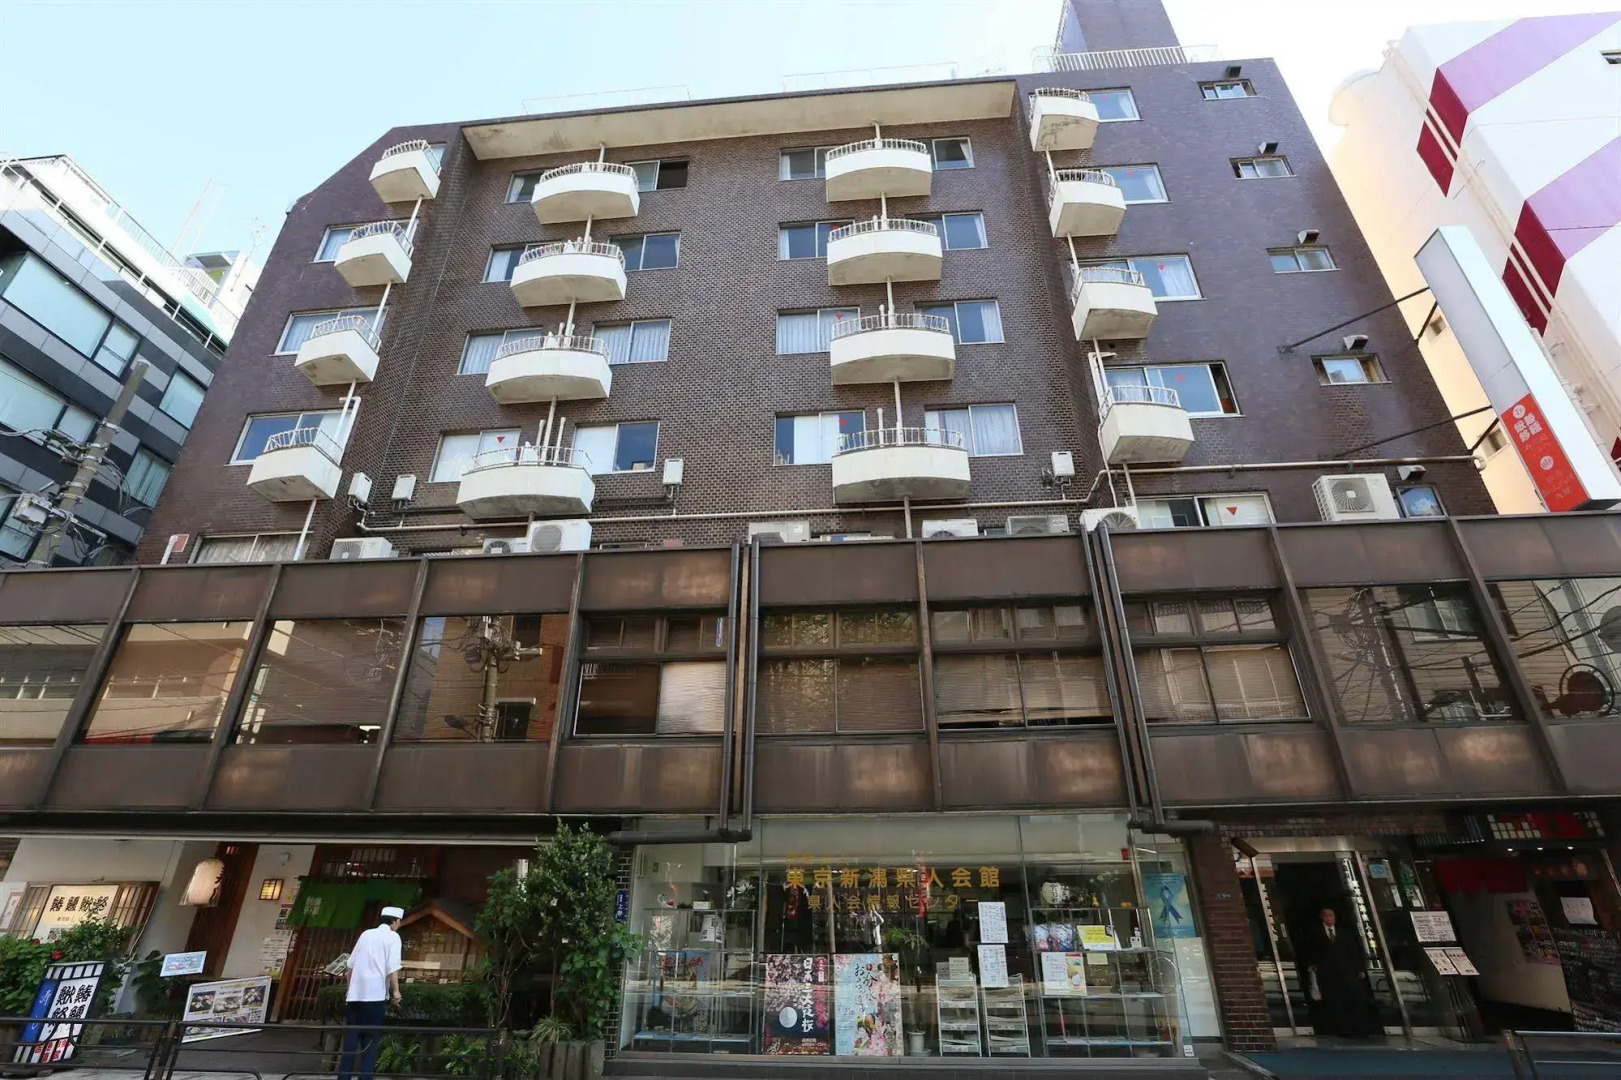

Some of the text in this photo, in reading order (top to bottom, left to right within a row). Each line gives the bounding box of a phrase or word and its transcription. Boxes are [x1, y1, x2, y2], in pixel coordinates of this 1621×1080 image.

[786, 866, 1000, 888] 東京新潟県人会館
